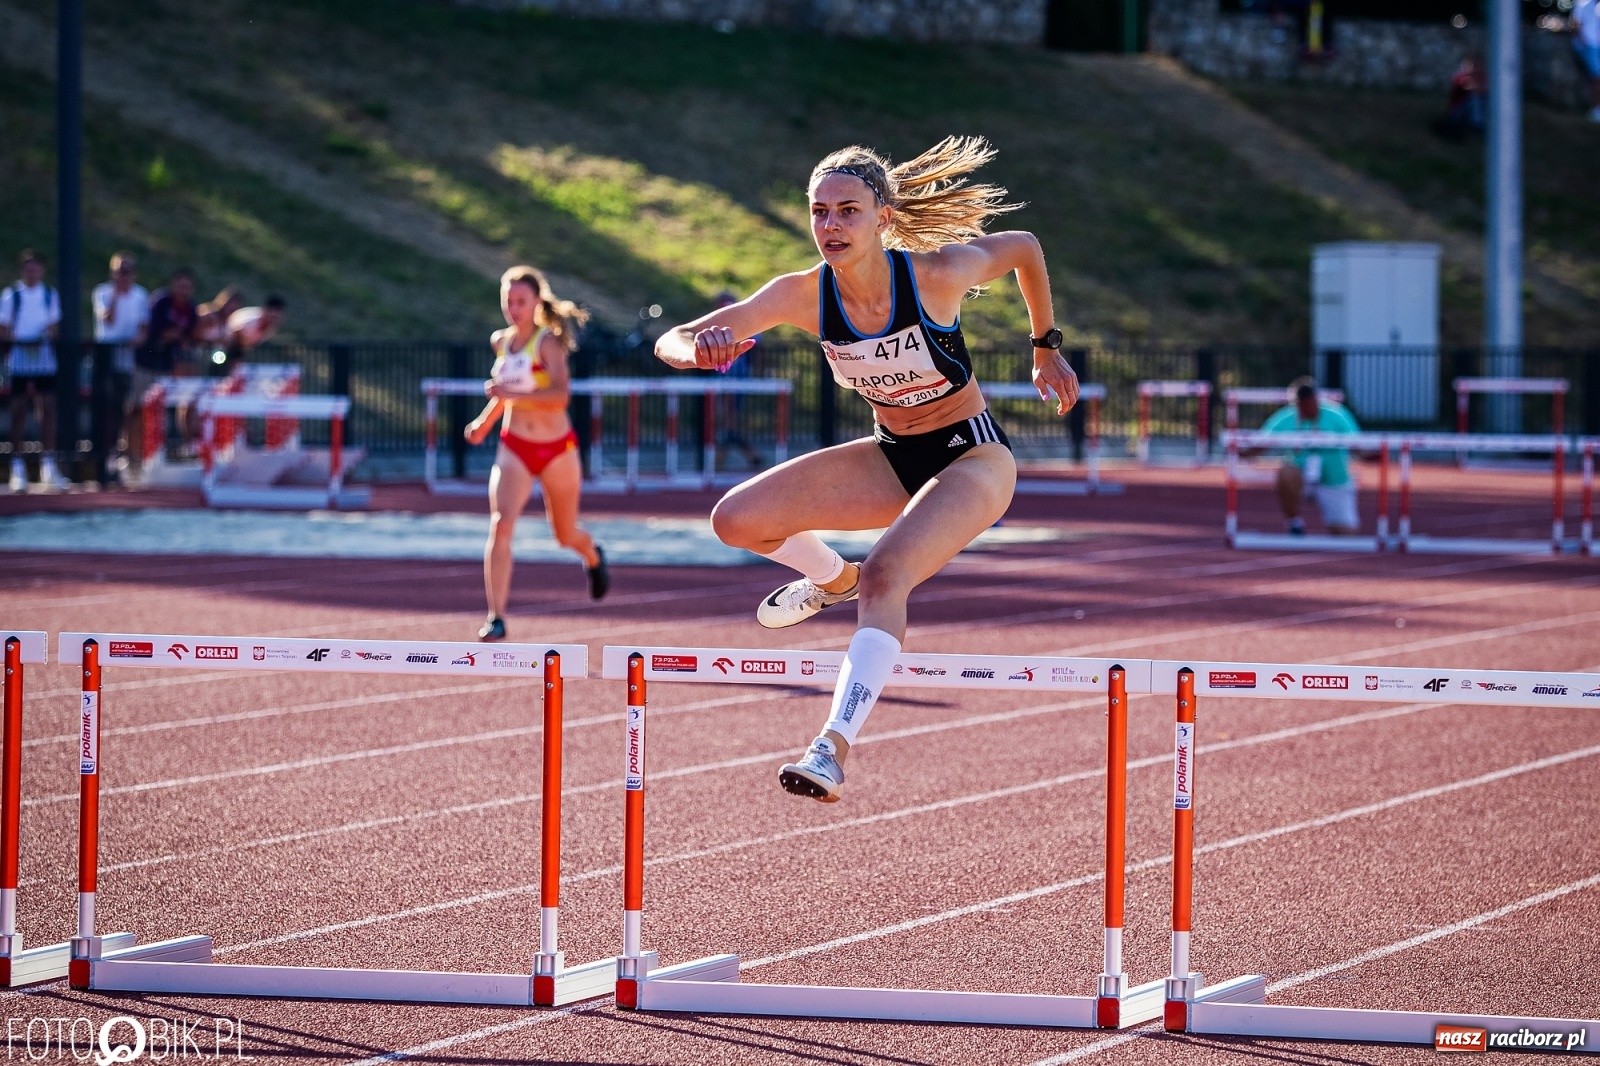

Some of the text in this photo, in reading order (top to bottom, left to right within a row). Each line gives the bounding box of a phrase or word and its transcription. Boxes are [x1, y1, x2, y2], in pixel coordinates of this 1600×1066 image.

[874, 331, 921, 360] 474
[847, 370, 923, 389] ZAPORA
[913, 388, 939, 402] 2019
[947, 439, 967, 448] adidas
[197, 647, 236, 658] ORLEN
[306, 648, 331, 662] 4F
[405, 655, 439, 664] 4MOVE
[743, 662, 783, 673] ORLEN
[960, 670, 995, 679] 4MOVE
[1304, 677, 1346, 688] ORLEN
[1423, 678, 1450, 692] 4F
[1531, 686, 1569, 696] 4MOVE
[82, 712, 93, 759] polanik
[628, 727, 640, 774] polanik
[1176, 744, 1188, 794] polanik
